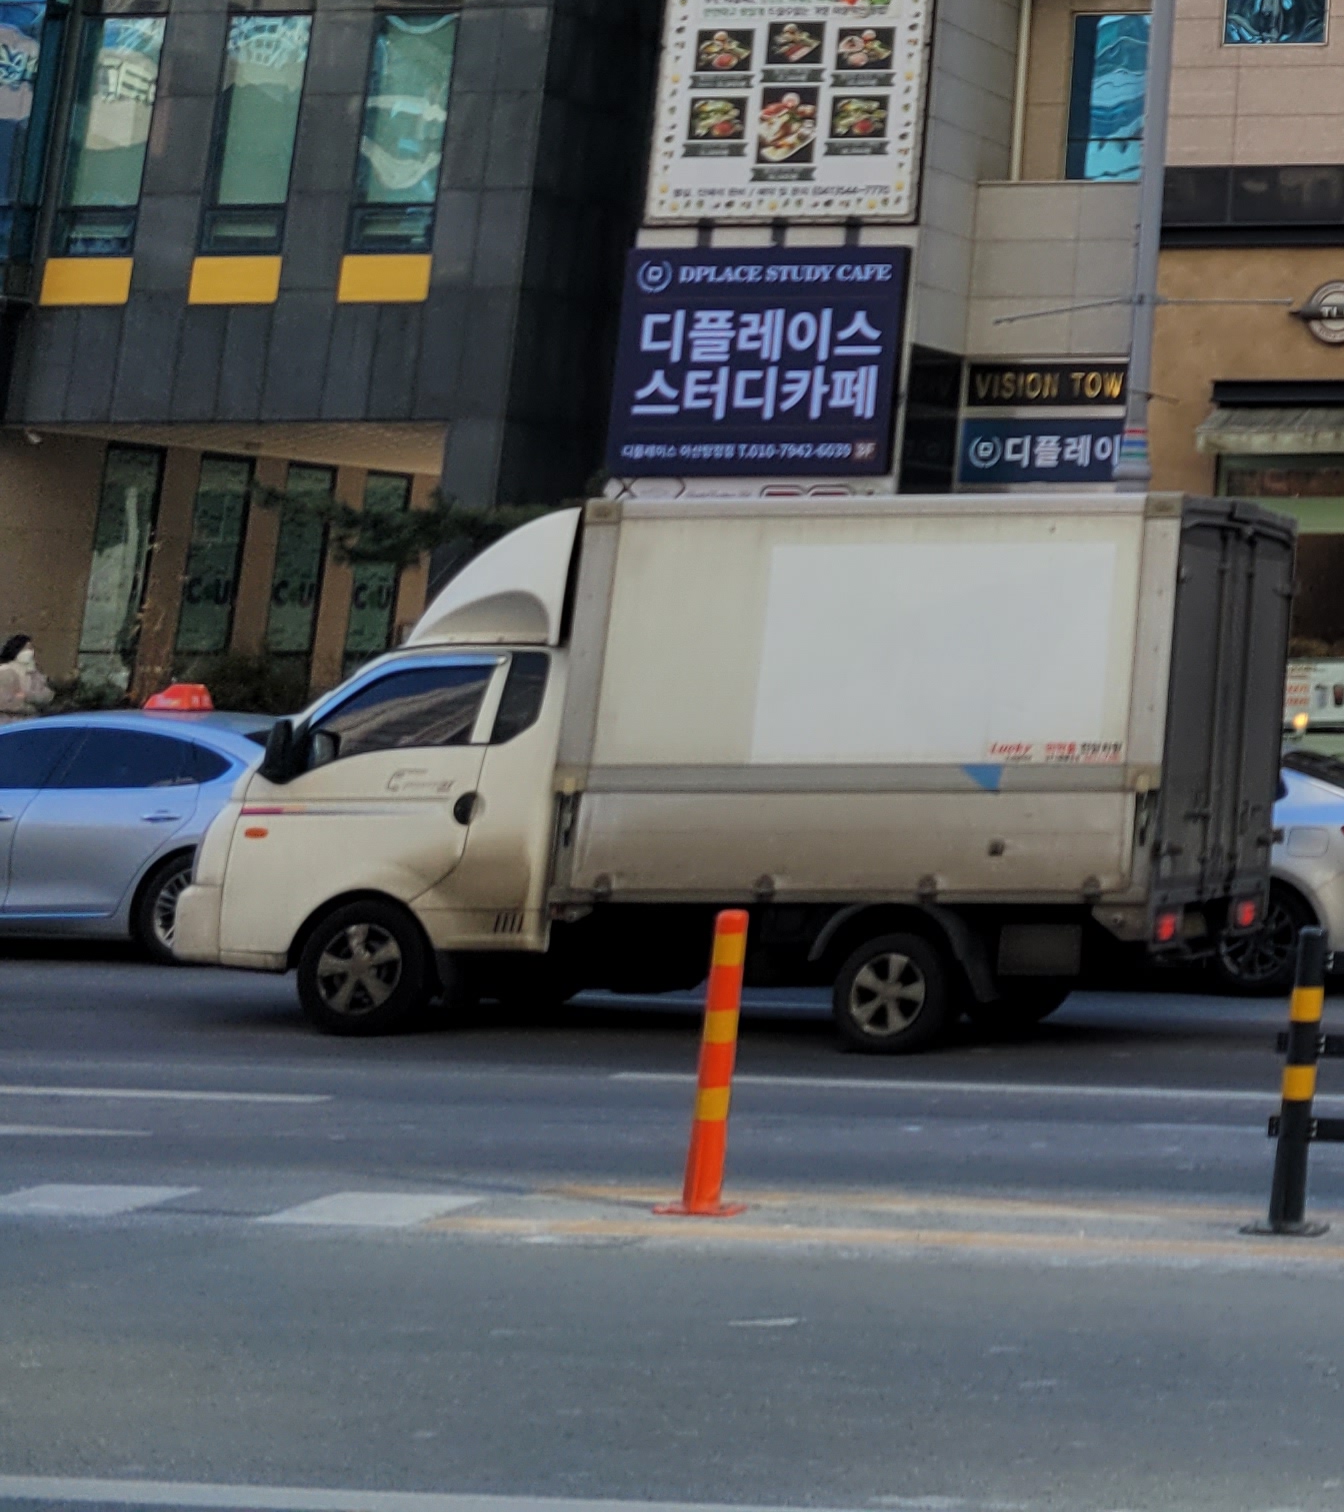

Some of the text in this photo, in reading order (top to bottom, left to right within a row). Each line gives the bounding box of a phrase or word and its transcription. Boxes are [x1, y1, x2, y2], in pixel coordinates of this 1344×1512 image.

[678, 263, 893, 284] DPLACE STUDY CAFE
[639, 306, 883, 363] 디플레이스
[630, 364, 879, 421] 스터디카페
[974, 370, 1125, 400] VISION TOW
[1003, 433, 1122, 468] 디플레이
